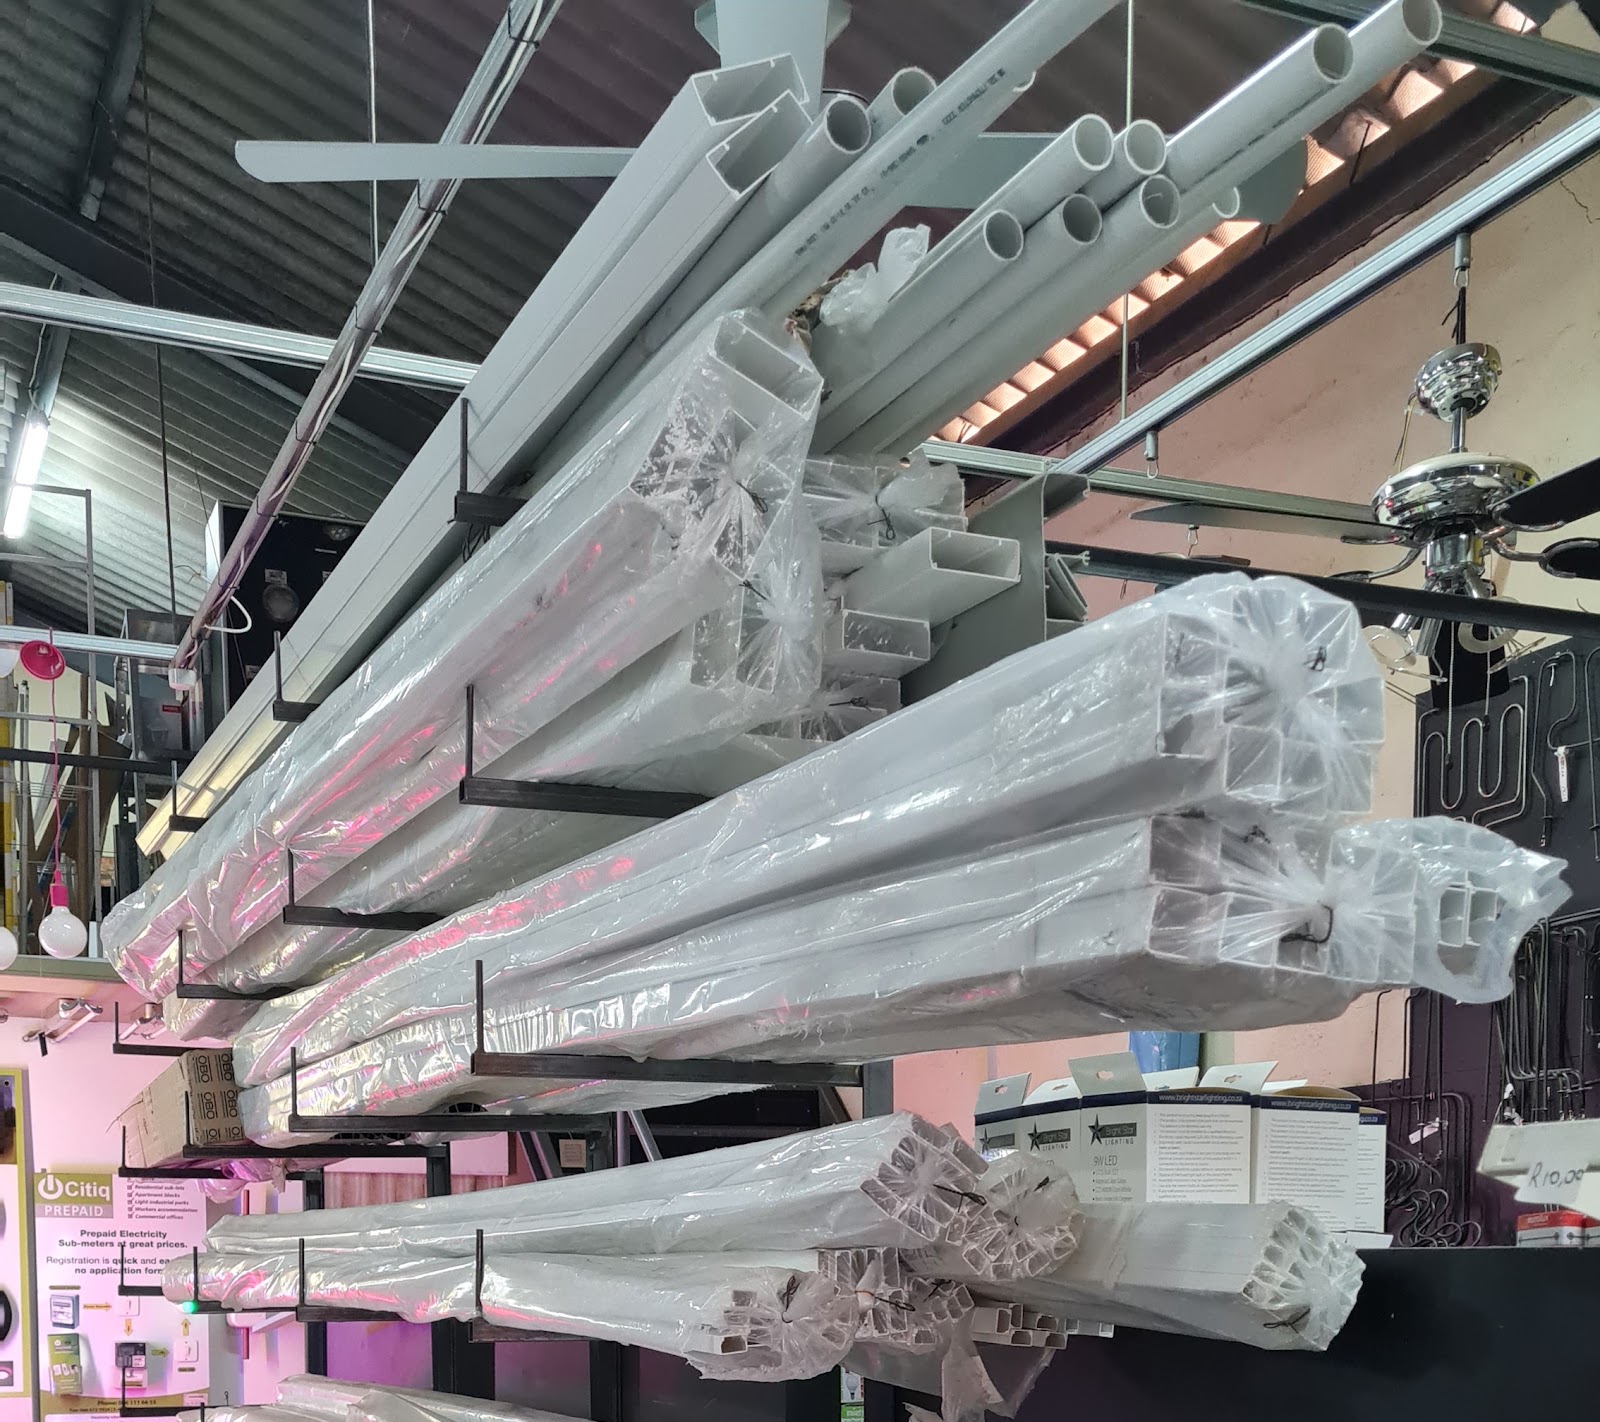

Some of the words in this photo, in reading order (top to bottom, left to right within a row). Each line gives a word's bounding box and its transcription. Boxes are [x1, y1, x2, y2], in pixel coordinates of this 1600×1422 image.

[198, 1055, 210, 1083] OBO
[221, 1053, 233, 1081] OBO
[203, 1091, 215, 1120] OBO
[226, 1089, 238, 1118] OBO
[1042, 1143, 1069, 1151] LIGHTING
[1105, 1138, 1134, 1146] LIGHTING
[1528, 1160, 1584, 1188] R10,00
[64, 1181, 111, 1202] Citiq
[44, 1204, 104, 1217] PREPAID
[80, 1229, 117, 1239] Prepaid
[119, 1230, 167, 1239] Electricity
[58, 1239, 114, 1247] Sub-meters
[129, 1241, 154, 1249] great
[156, 1241, 188, 1249] prices.
[46, 1256, 100, 1266] Registration
